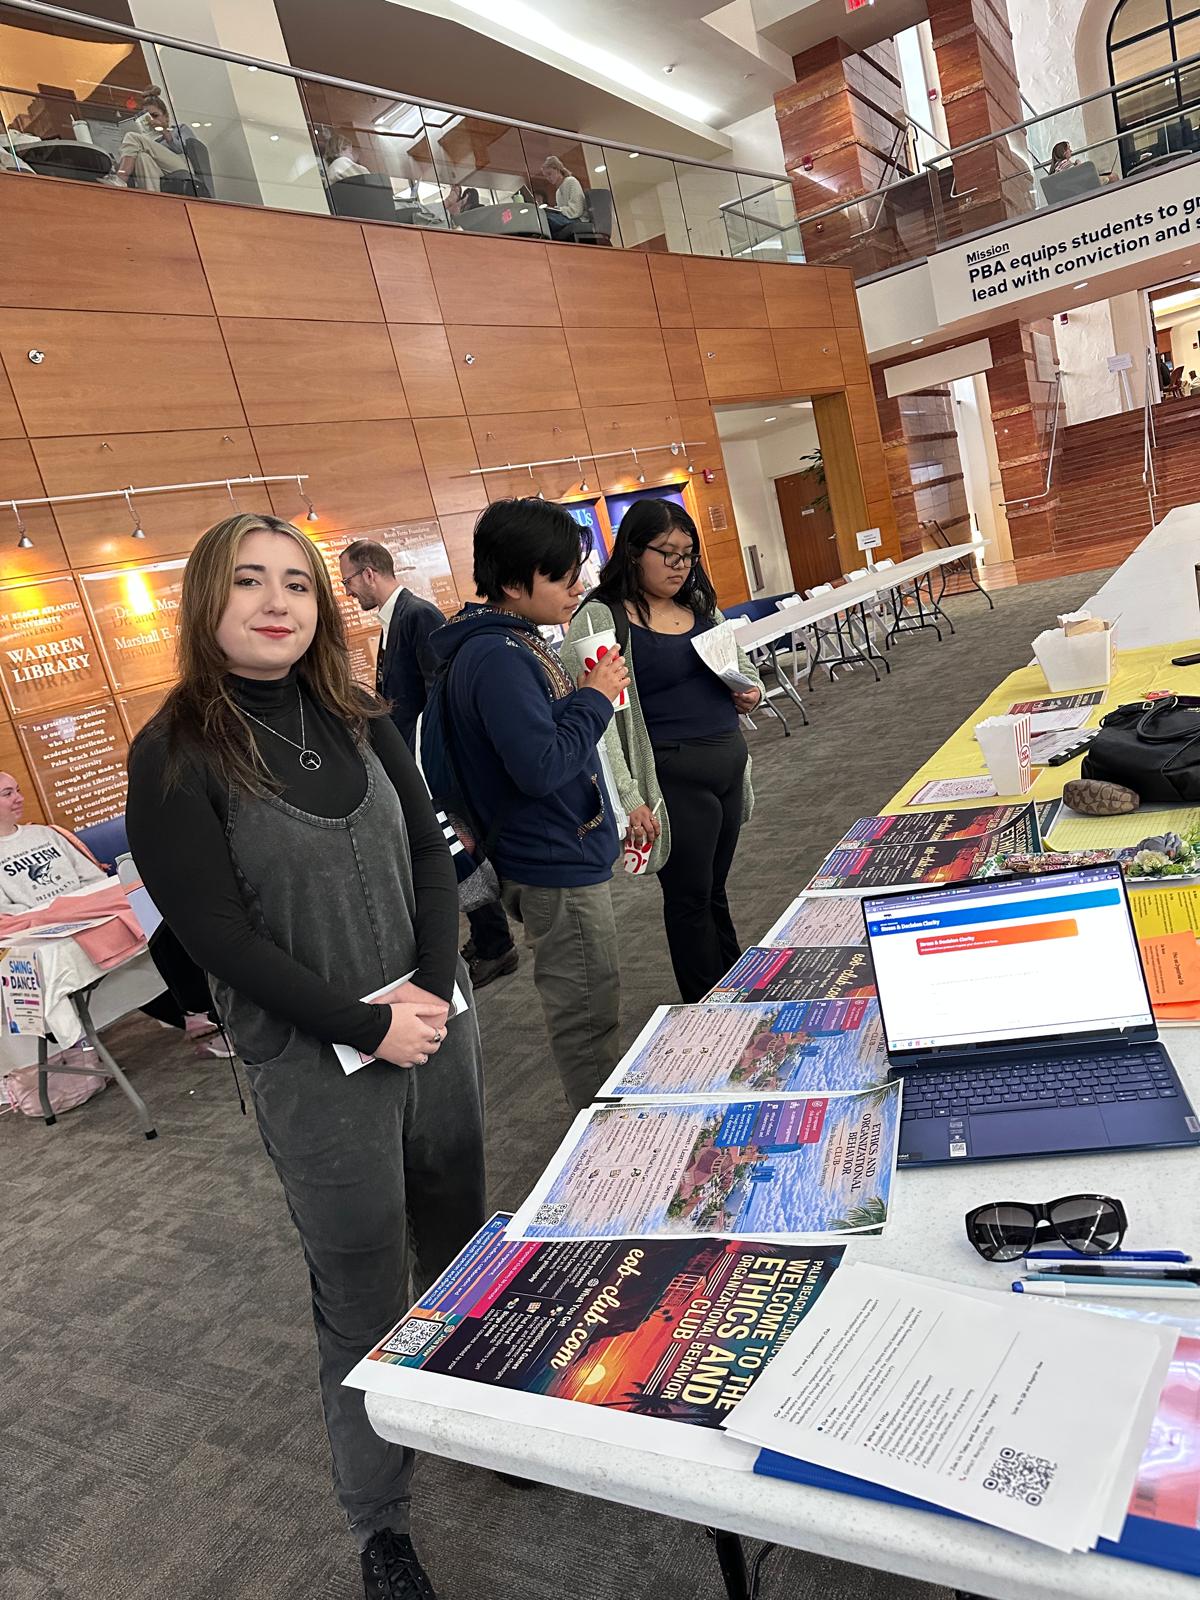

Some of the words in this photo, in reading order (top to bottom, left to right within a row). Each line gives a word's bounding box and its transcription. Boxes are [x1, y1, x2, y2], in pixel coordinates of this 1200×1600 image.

[966, 242, 1010, 264] Mission
[968, 261, 1006, 283] PBA
[1010, 242, 1067, 268] equips
[1072, 212, 1153, 248] students
[1158, 205, 1177, 219] to
[972, 279, 1008, 301] lead
[1012, 267, 1050, 288] with
[1055, 235, 1149, 274] conviction
[1156, 218, 1190, 242] and
[577, 509, 593, 526] Us
[42, 602, 80, 614] ATLANTIC
[13, 616, 60, 630] UNIVERSITY
[114, 629, 160, 649] Marshall
[160, 627, 174, 639] E.
[6, 636, 85, 663] WARREN
[12, 654, 90, 682] LIBRARY
[43, 717, 69, 731] grateful
[71, 709, 106, 721] recognition
[64, 725, 81, 736] major
[83, 719, 106, 729] donors
[48, 740, 63, 748] who
[76, 728, 104, 741] ensuring
[43, 747, 73, 760] academic
[74, 738, 107, 751] excellence
[51, 759, 68, 768] Palm
[69, 753, 88, 763] Beach
[90, 746, 113, 757] Atlantic
[70, 759, 102, 772] University
[54, 775, 81, 788] through
[82, 770, 96, 780] gifts
[98, 765, 114, 774] made
[57, 796, 79, 808] extend
[94, 780, 128, 796] appreciatio
[68, 783, 91, 793] Warren
[84, 792, 122, 809] contributors
[74, 814, 85, 822] the
[86, 804, 117, 818] Campaign
[73, 824, 84, 832] the
[86, 817, 109, 828] Warren
[901, 922, 922, 930] Decision
[9, 960, 32, 975] SWING
[10, 976, 36, 990] DANCE
[683, 1124, 699, 1144] Connect
[869, 1123, 881, 1155] ETHICS
[675, 1148, 689, 1163] Learn
[833, 1146, 842, 1165] CLUB
[842, 1132, 857, 1175] BEHAVIOR
[851, 1114, 871, 1192] ORGANIZATIONAL
[668, 1168, 681, 1180] Lead
[866, 1158, 876, 1177] AND
[658, 1185, 674, 1200] Serve
[589, 1253, 603, 1265] about
[526, 1260, 549, 1282] philosophy
[572, 1265, 594, 1287] professors
[806, 1260, 824, 1287] PALM
[574, 1287, 593, 1303] What
[695, 1255, 754, 1339] ORGANIZATIONAL
[716, 1256, 786, 1340] ETHICS
[751, 1259, 810, 1341] WELCOME
[795, 1285, 813, 1312] BEACH
[494, 1310, 509, 1323] Bingo
[550, 1248, 644, 1370] eob-club.com
[565, 1302, 581, 1315] You
[513, 1324, 524, 1332] the
[519, 1314, 532, 1324] Find
[556, 1315, 571, 1327] Get
[670, 1300, 713, 1342] CLUB
[432, 1333, 447, 1345] Join
[483, 1323, 498, 1336] Game
[503, 1332, 517, 1344] word
[527, 1317, 555, 1347] Competitions
[771, 1313, 800, 1356] ATLANTIC
[821, 1326, 832, 1335] Club
[422, 1344, 436, 1356] Now
[738, 1346, 768, 1368] TO
[510, 1352, 528, 1369] Games
[661, 1340, 706, 1399] BEHAVIOR
[682, 1344, 736, 1404] AND
[714, 1375, 754, 1410] THE
[772, 1409, 782, 1417] Our
[820, 1418, 829, 1426] Our
[864, 1430, 878, 1442] What
[877, 1410, 890, 1422] Offer
